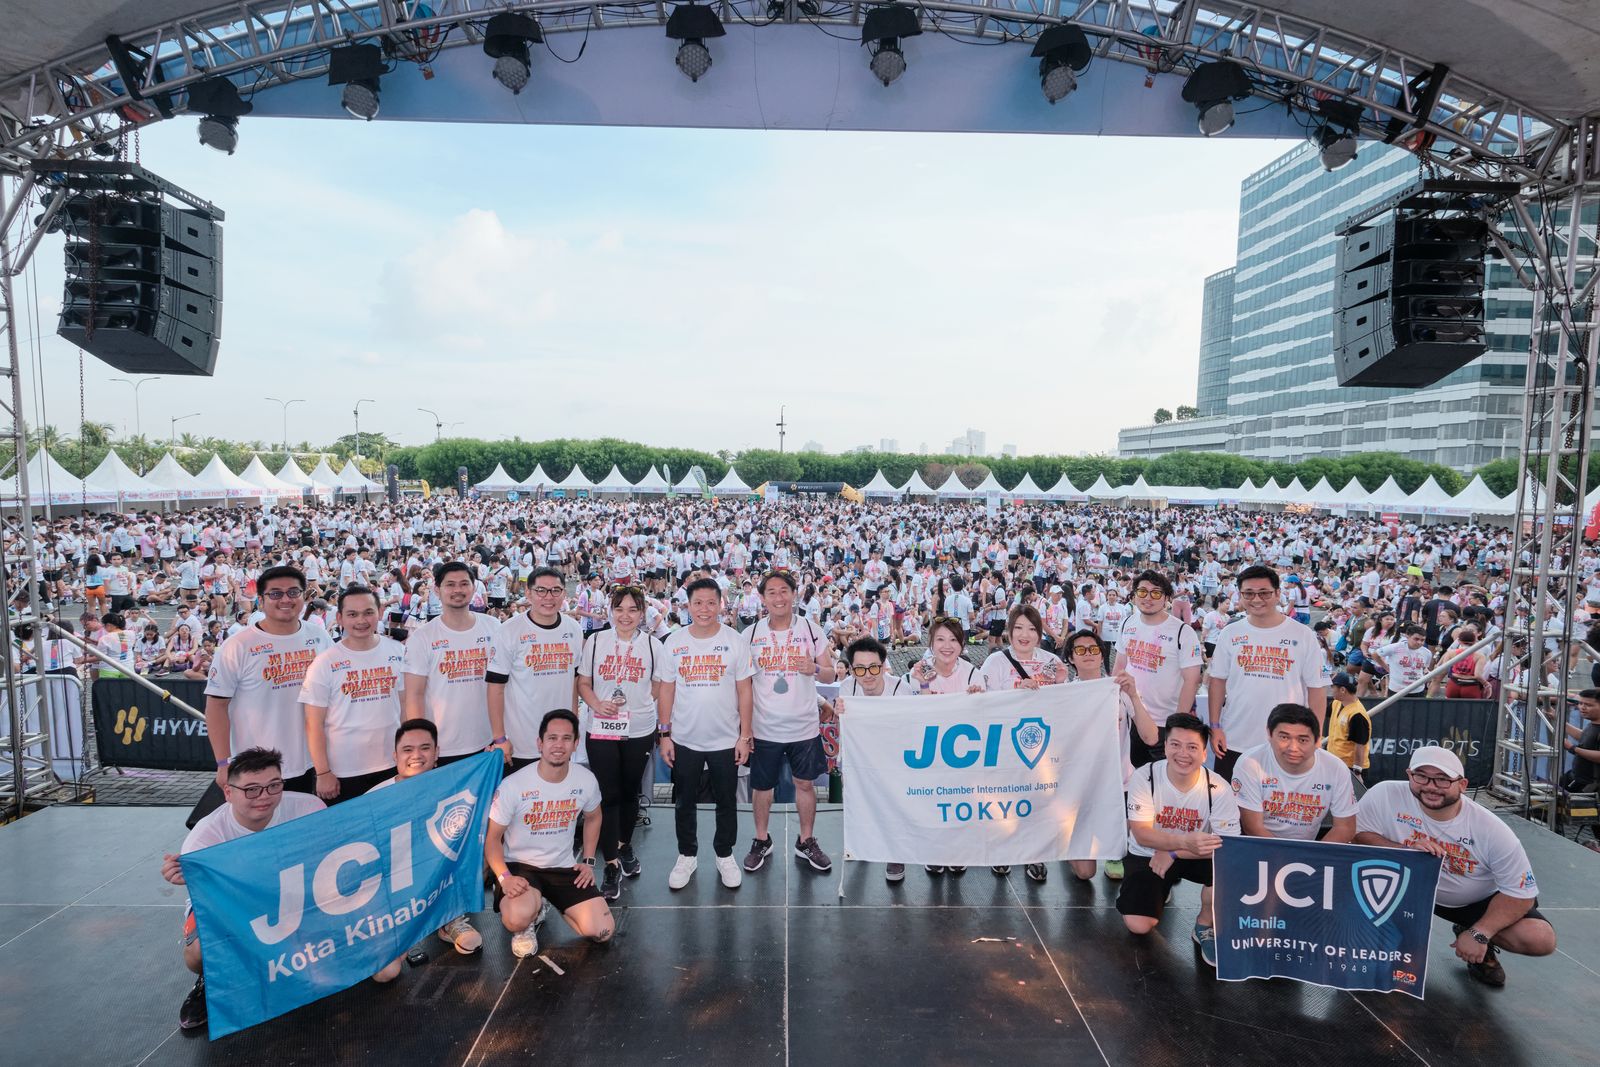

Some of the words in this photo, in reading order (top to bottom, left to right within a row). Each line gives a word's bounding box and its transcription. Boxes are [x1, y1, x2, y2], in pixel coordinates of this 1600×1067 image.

[601, 722, 627, 730] 12687
[904, 724, 1003, 769] JCI
[907, 787, 934, 796] Junior
[936, 786, 974, 795] Chamber
[977, 783, 1031, 793] International
[1035, 781, 1058, 791] Japan
[937, 800, 1032, 822] TOKYO
[250, 821, 413, 945] JCI
[1240, 861, 1334, 910] JCI
[1239, 916, 1286, 930] Manila
[1404, 911, 1414, 919] TM
[268, 938, 336, 982] Kota
[345, 872, 453, 946] Kinabalu
[1232, 937, 1318, 953] UNIVERSITY
[1325, 945, 1346, 957] OF
[1352, 948, 1412, 963] LEADERS
[1329, 962, 1367, 973] 1948
